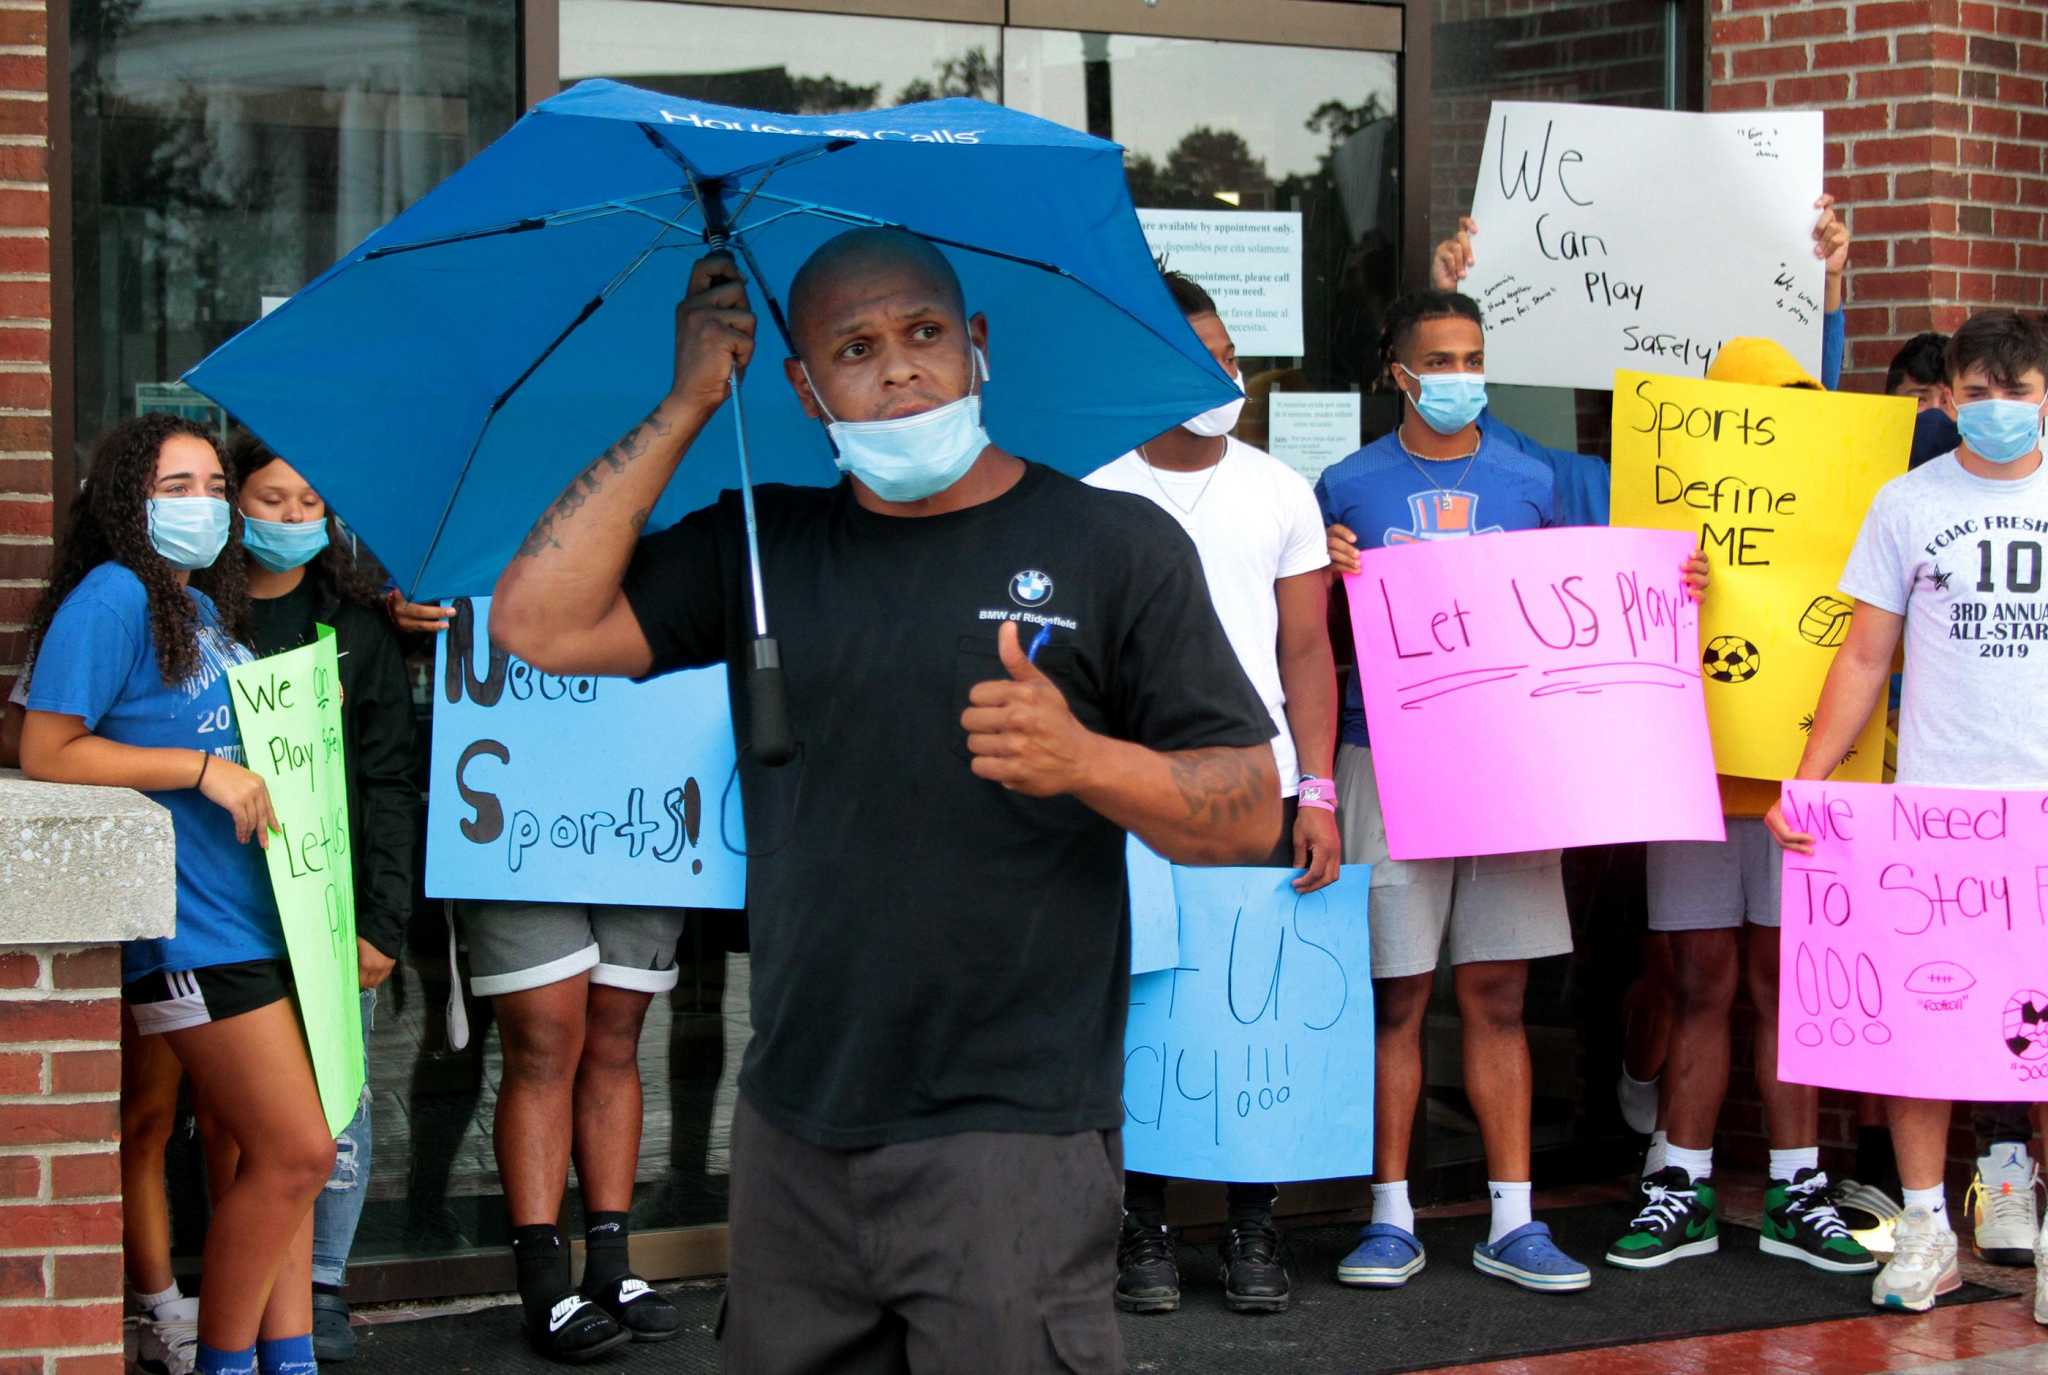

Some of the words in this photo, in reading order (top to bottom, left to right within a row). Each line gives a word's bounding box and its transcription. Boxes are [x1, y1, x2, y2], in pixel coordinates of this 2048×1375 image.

[1499, 114, 1594, 206] We
[1536, 213, 1607, 261] Can
[1244, 271, 1272, 284] please
[1273, 272, 1291, 283] call
[1585, 271, 1643, 310] Play
[1631, 380, 1776, 459] Sports
[1655, 464, 1796, 516] Define
[1700, 523, 1774, 566] ME
[1925, 519, 1979, 556] FCIAC
[1976, 540, 2042, 593] 10
[978, 610, 1008, 620] BMW
[1009, 611, 1022, 621] of
[1380, 578, 1471, 659] Let
[1950, 602, 1988, 622] 3RD
[1979, 643, 2029, 659] 2019
[237, 673, 296, 714] We
[268, 735, 316, 793] Play
[456, 738, 703, 875] Sports!
[1787, 788, 1854, 842] We
[1893, 793, 2007, 842] Need
[281, 816, 332, 878] Let
[1788, 866, 1851, 927] To
[1879, 863, 2012, 936] Stay
[1228, 889, 1348, 1031] US
[551, 1295, 581, 1322] NIKE
